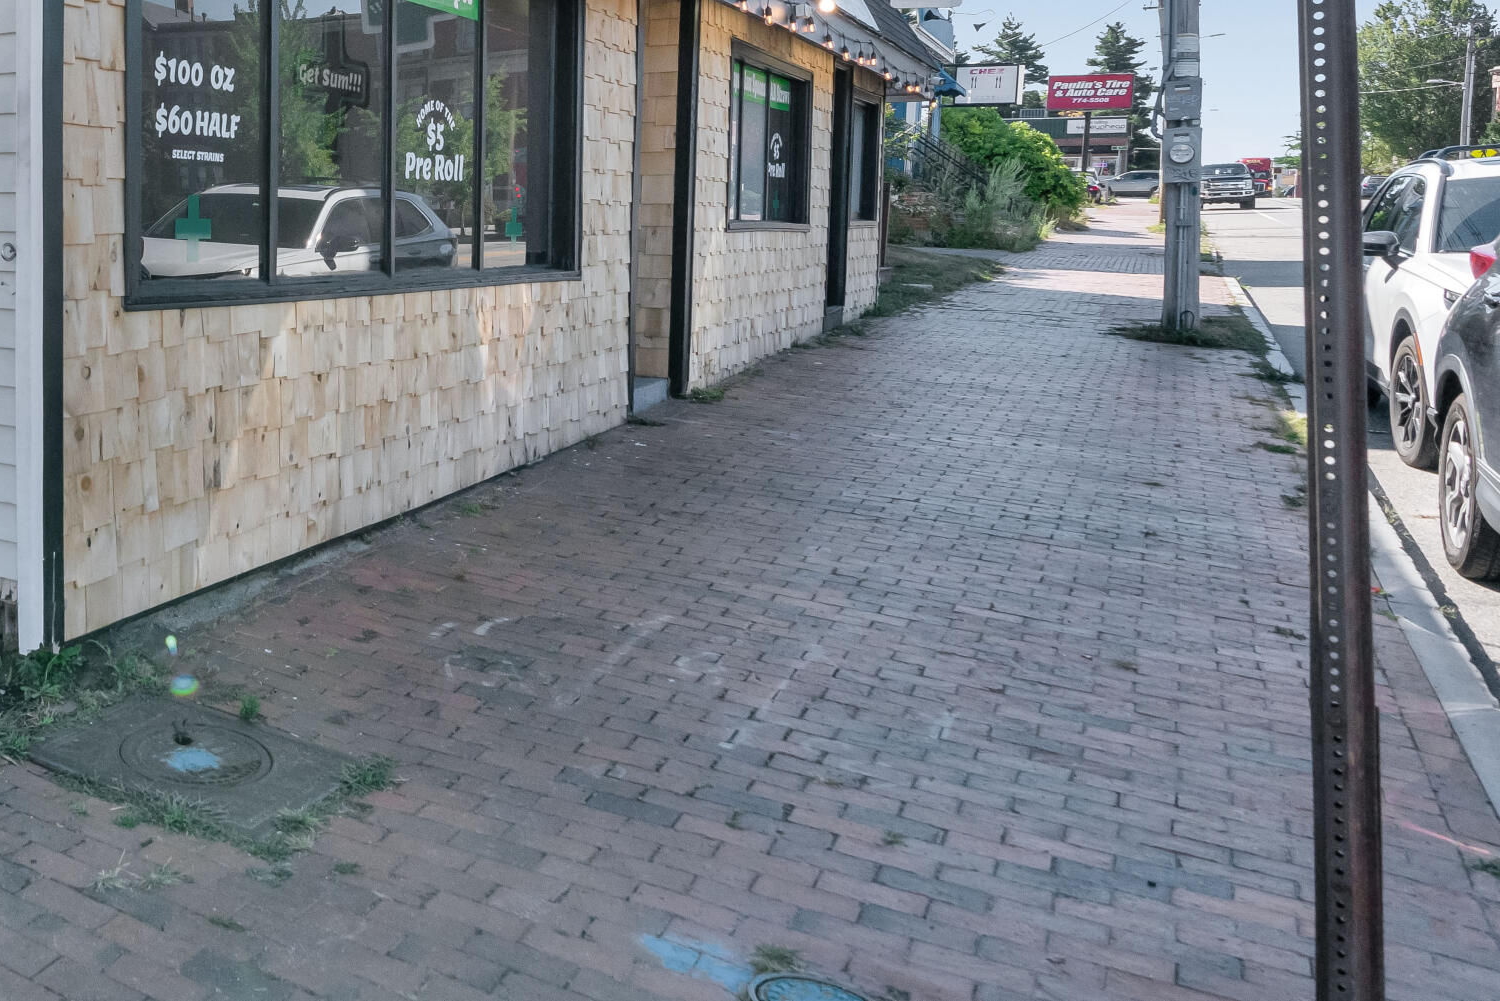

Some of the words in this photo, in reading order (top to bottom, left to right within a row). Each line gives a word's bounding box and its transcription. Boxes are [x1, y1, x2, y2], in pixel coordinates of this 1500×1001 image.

[154, 50, 204, 87] $100
[210, 64, 236, 93] OZ
[300, 62, 320, 86] Get
[1052, 80, 1103, 90] Paulin's
[1105, 80, 1131, 89] Tire
[1054, 89, 1064, 98] &
[1065, 89, 1095, 97] Auto
[1096, 88, 1128, 96] Care
[155, 102, 193, 138] $60
[195, 109, 241, 139] HALF
[416, 100, 435, 128] HOME
[435, 99, 445, 112] OF
[444, 107, 457, 132] THE
[426, 117, 445, 152] $5
[172, 149, 196, 161] SELECT
[196, 150, 225, 163] STRAINS
[405, 152, 432, 181] Pre
[434, 153, 465, 182] Roll
